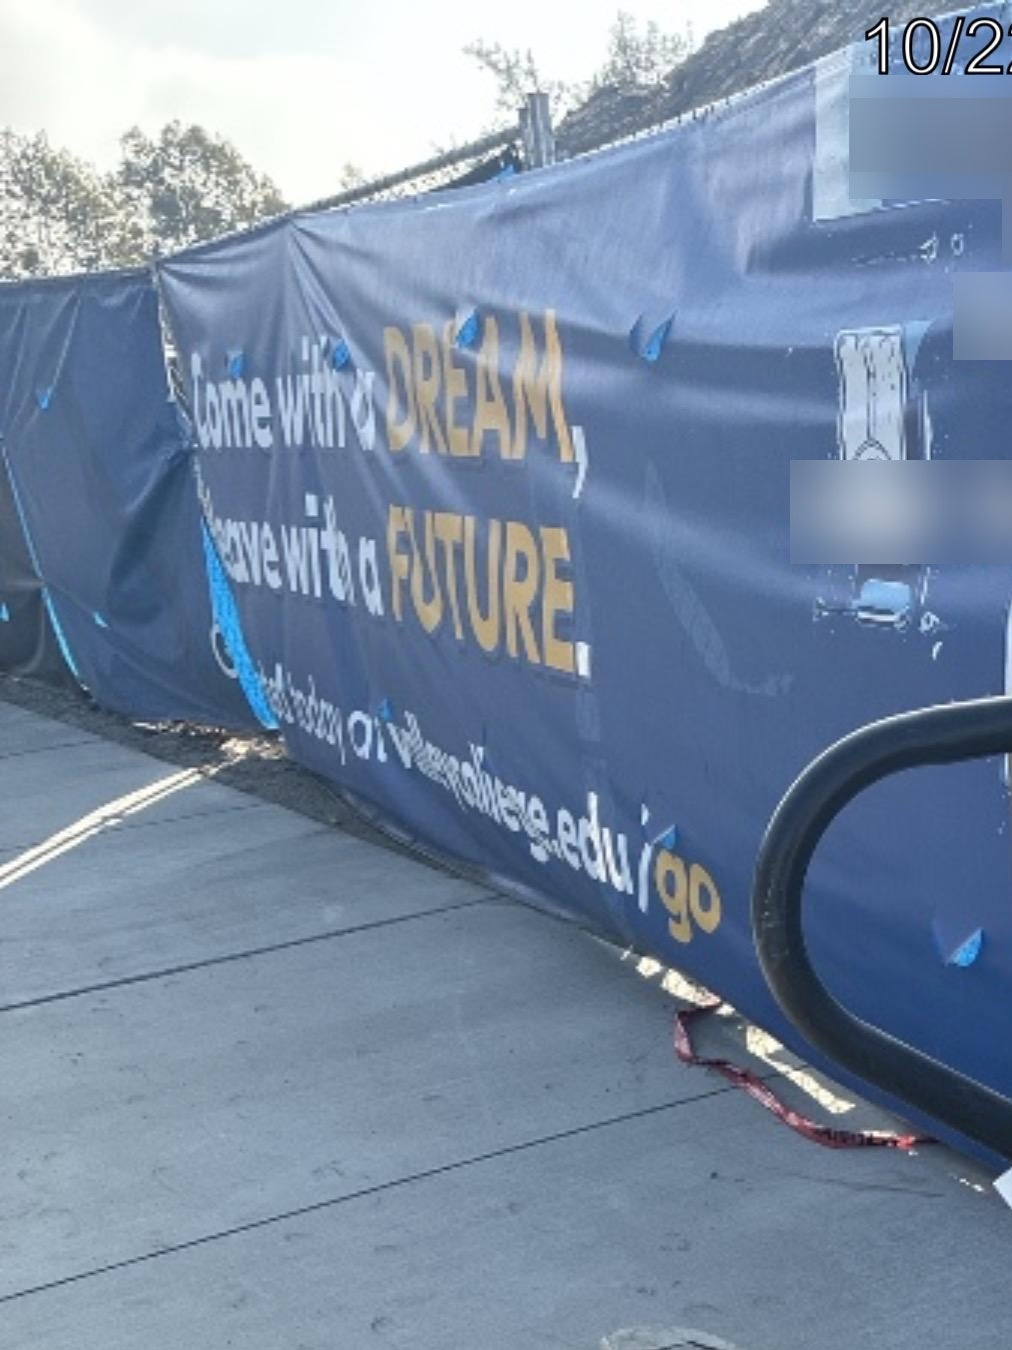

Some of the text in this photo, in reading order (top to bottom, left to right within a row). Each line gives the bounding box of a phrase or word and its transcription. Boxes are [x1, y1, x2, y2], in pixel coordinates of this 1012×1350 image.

[275, 335, 346, 448] with
[351, 368, 376, 450] a
[384, 308, 588, 498] DREAM,
[203, 492, 282, 589] eave
[359, 536, 384, 616] a
[386, 503, 591, 678] FUTURE.
